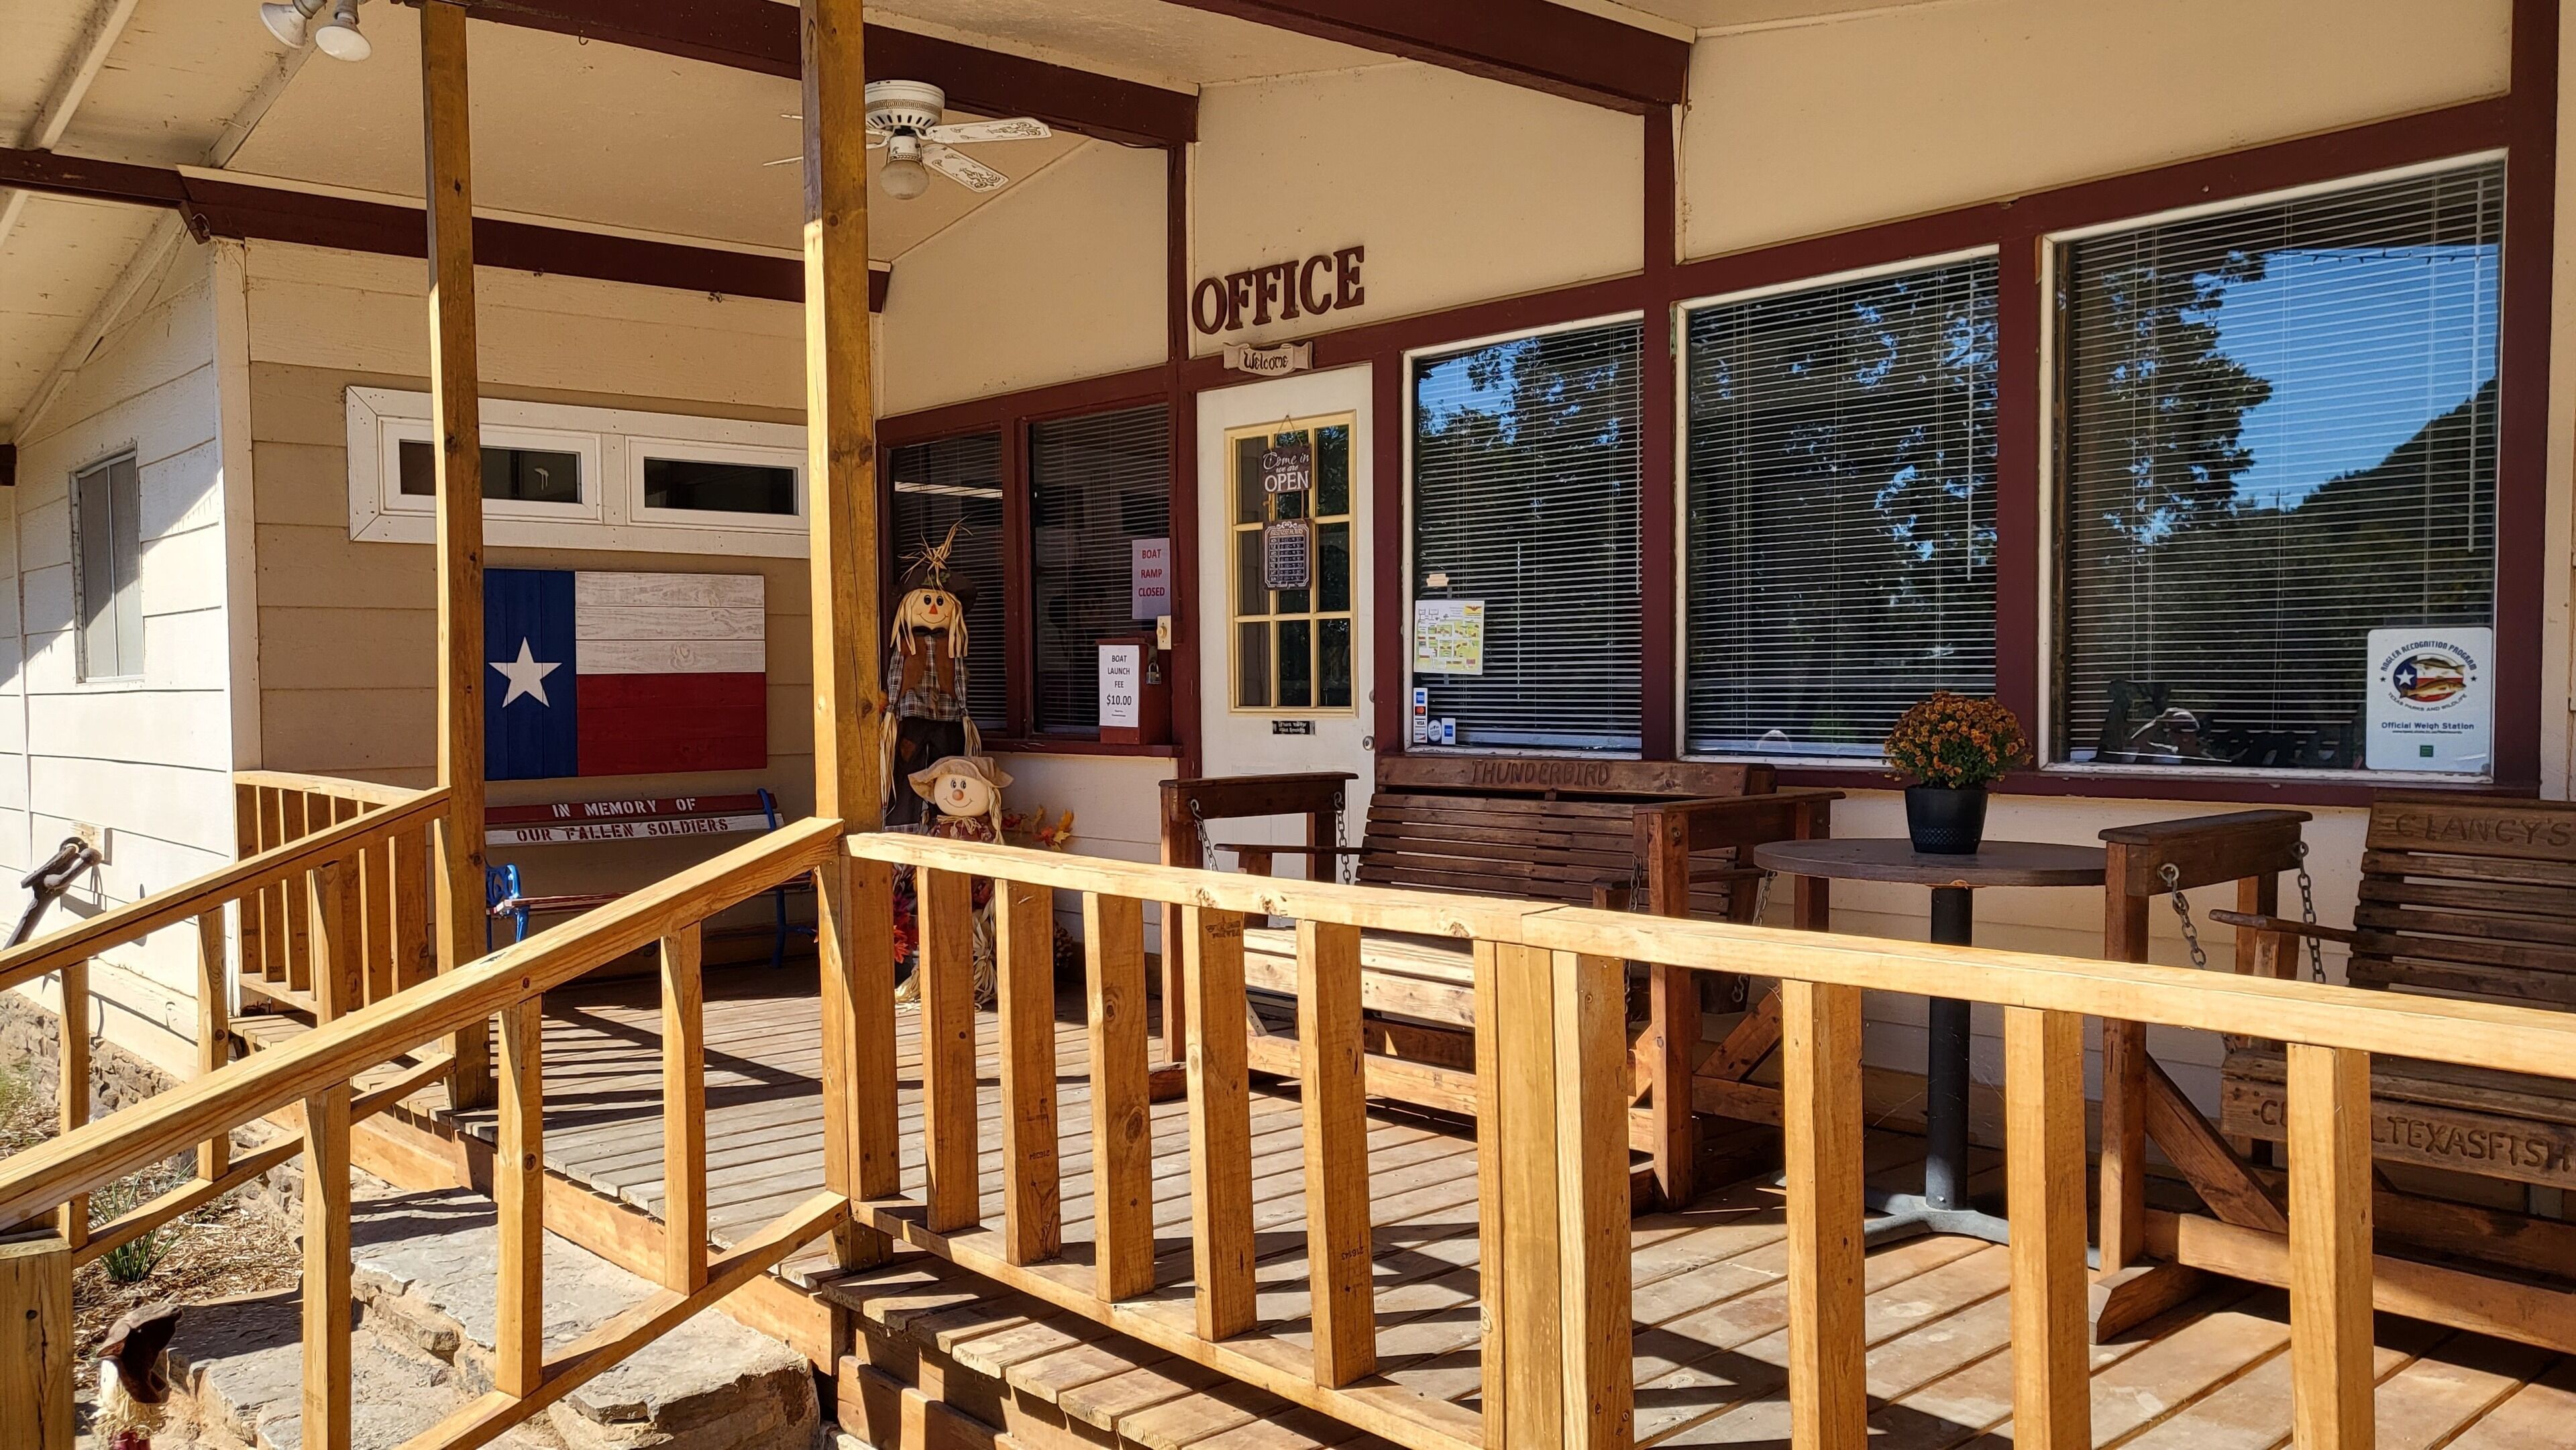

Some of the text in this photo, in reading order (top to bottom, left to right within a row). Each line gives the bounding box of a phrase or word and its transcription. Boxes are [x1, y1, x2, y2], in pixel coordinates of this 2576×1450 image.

[1192, 246, 1364, 335] OFFICE
[1244, 351, 1289, 369] Welcome
[1263, 452, 1309, 470] Come in
[1265, 470, 1309, 492] OPEN
[1142, 549, 1161, 559] BOAT
[1140, 568, 1163, 578] RAMP
[1138, 587, 1165, 597] CLOSED
[2380, 641, 2477, 671] ANGLER RECOGNITION PROGRAM
[1106, 693, 1132, 706] $10.00
[2388, 692, 2404, 706] TEXAS
[2404, 703, 2424, 711] PARKS
[2441, 693, 2467, 709] WILDLIFE
[1472, 760, 1610, 786] THUNDERBIRD
[552, 798, 696, 817] IN MEMORY OF
[517, 819, 729, 842] OUR FALLEN SOLDIERS
[2395, 813, 2572, 847] CLANCY'S
[1342, 1246, 1363, 1260] 216143
